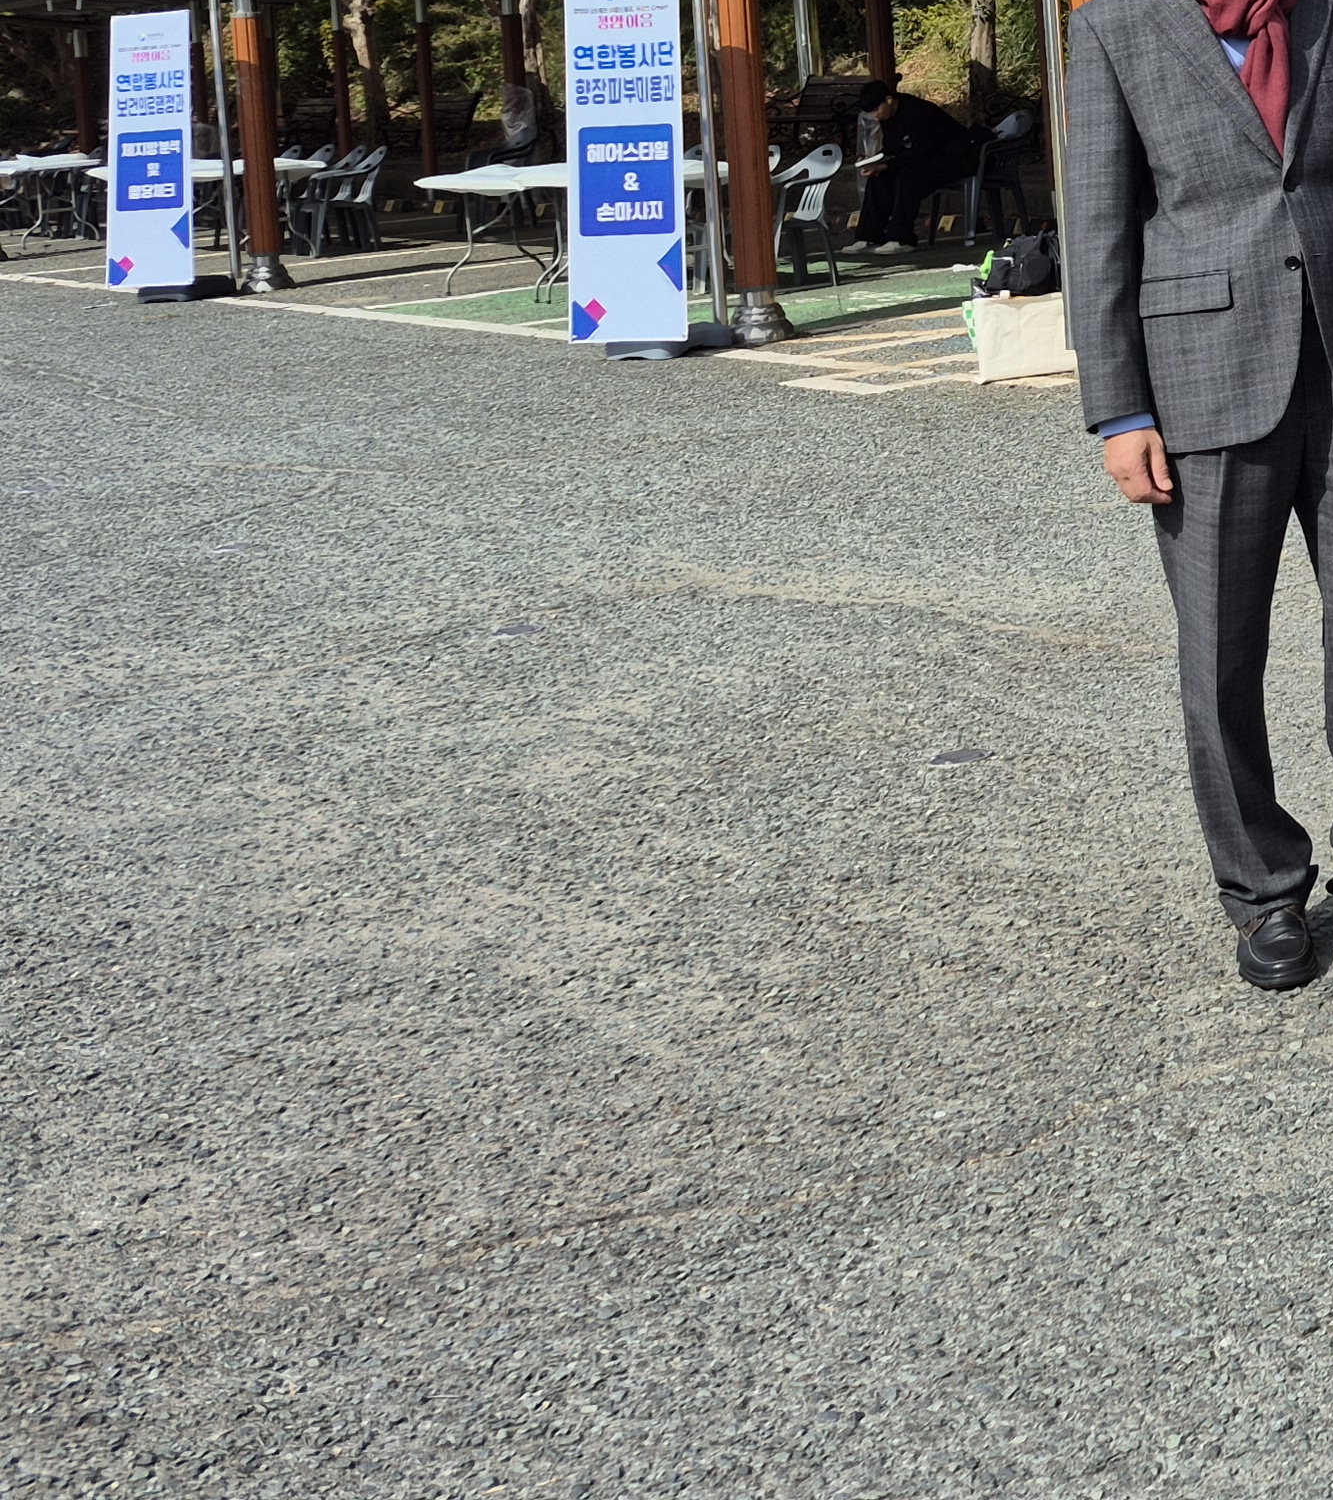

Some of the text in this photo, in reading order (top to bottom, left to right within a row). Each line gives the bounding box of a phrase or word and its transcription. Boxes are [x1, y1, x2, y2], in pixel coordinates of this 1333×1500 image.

[573, 41, 674, 70] 연합봉사단
[116, 70, 184, 92] 연합봉사단
[575, 74, 675, 105] 향장피부미용과
[586, 140, 670, 163] 헤어스타일
[623, 172, 641, 191] &
[596, 200, 664, 222] 손마사지
